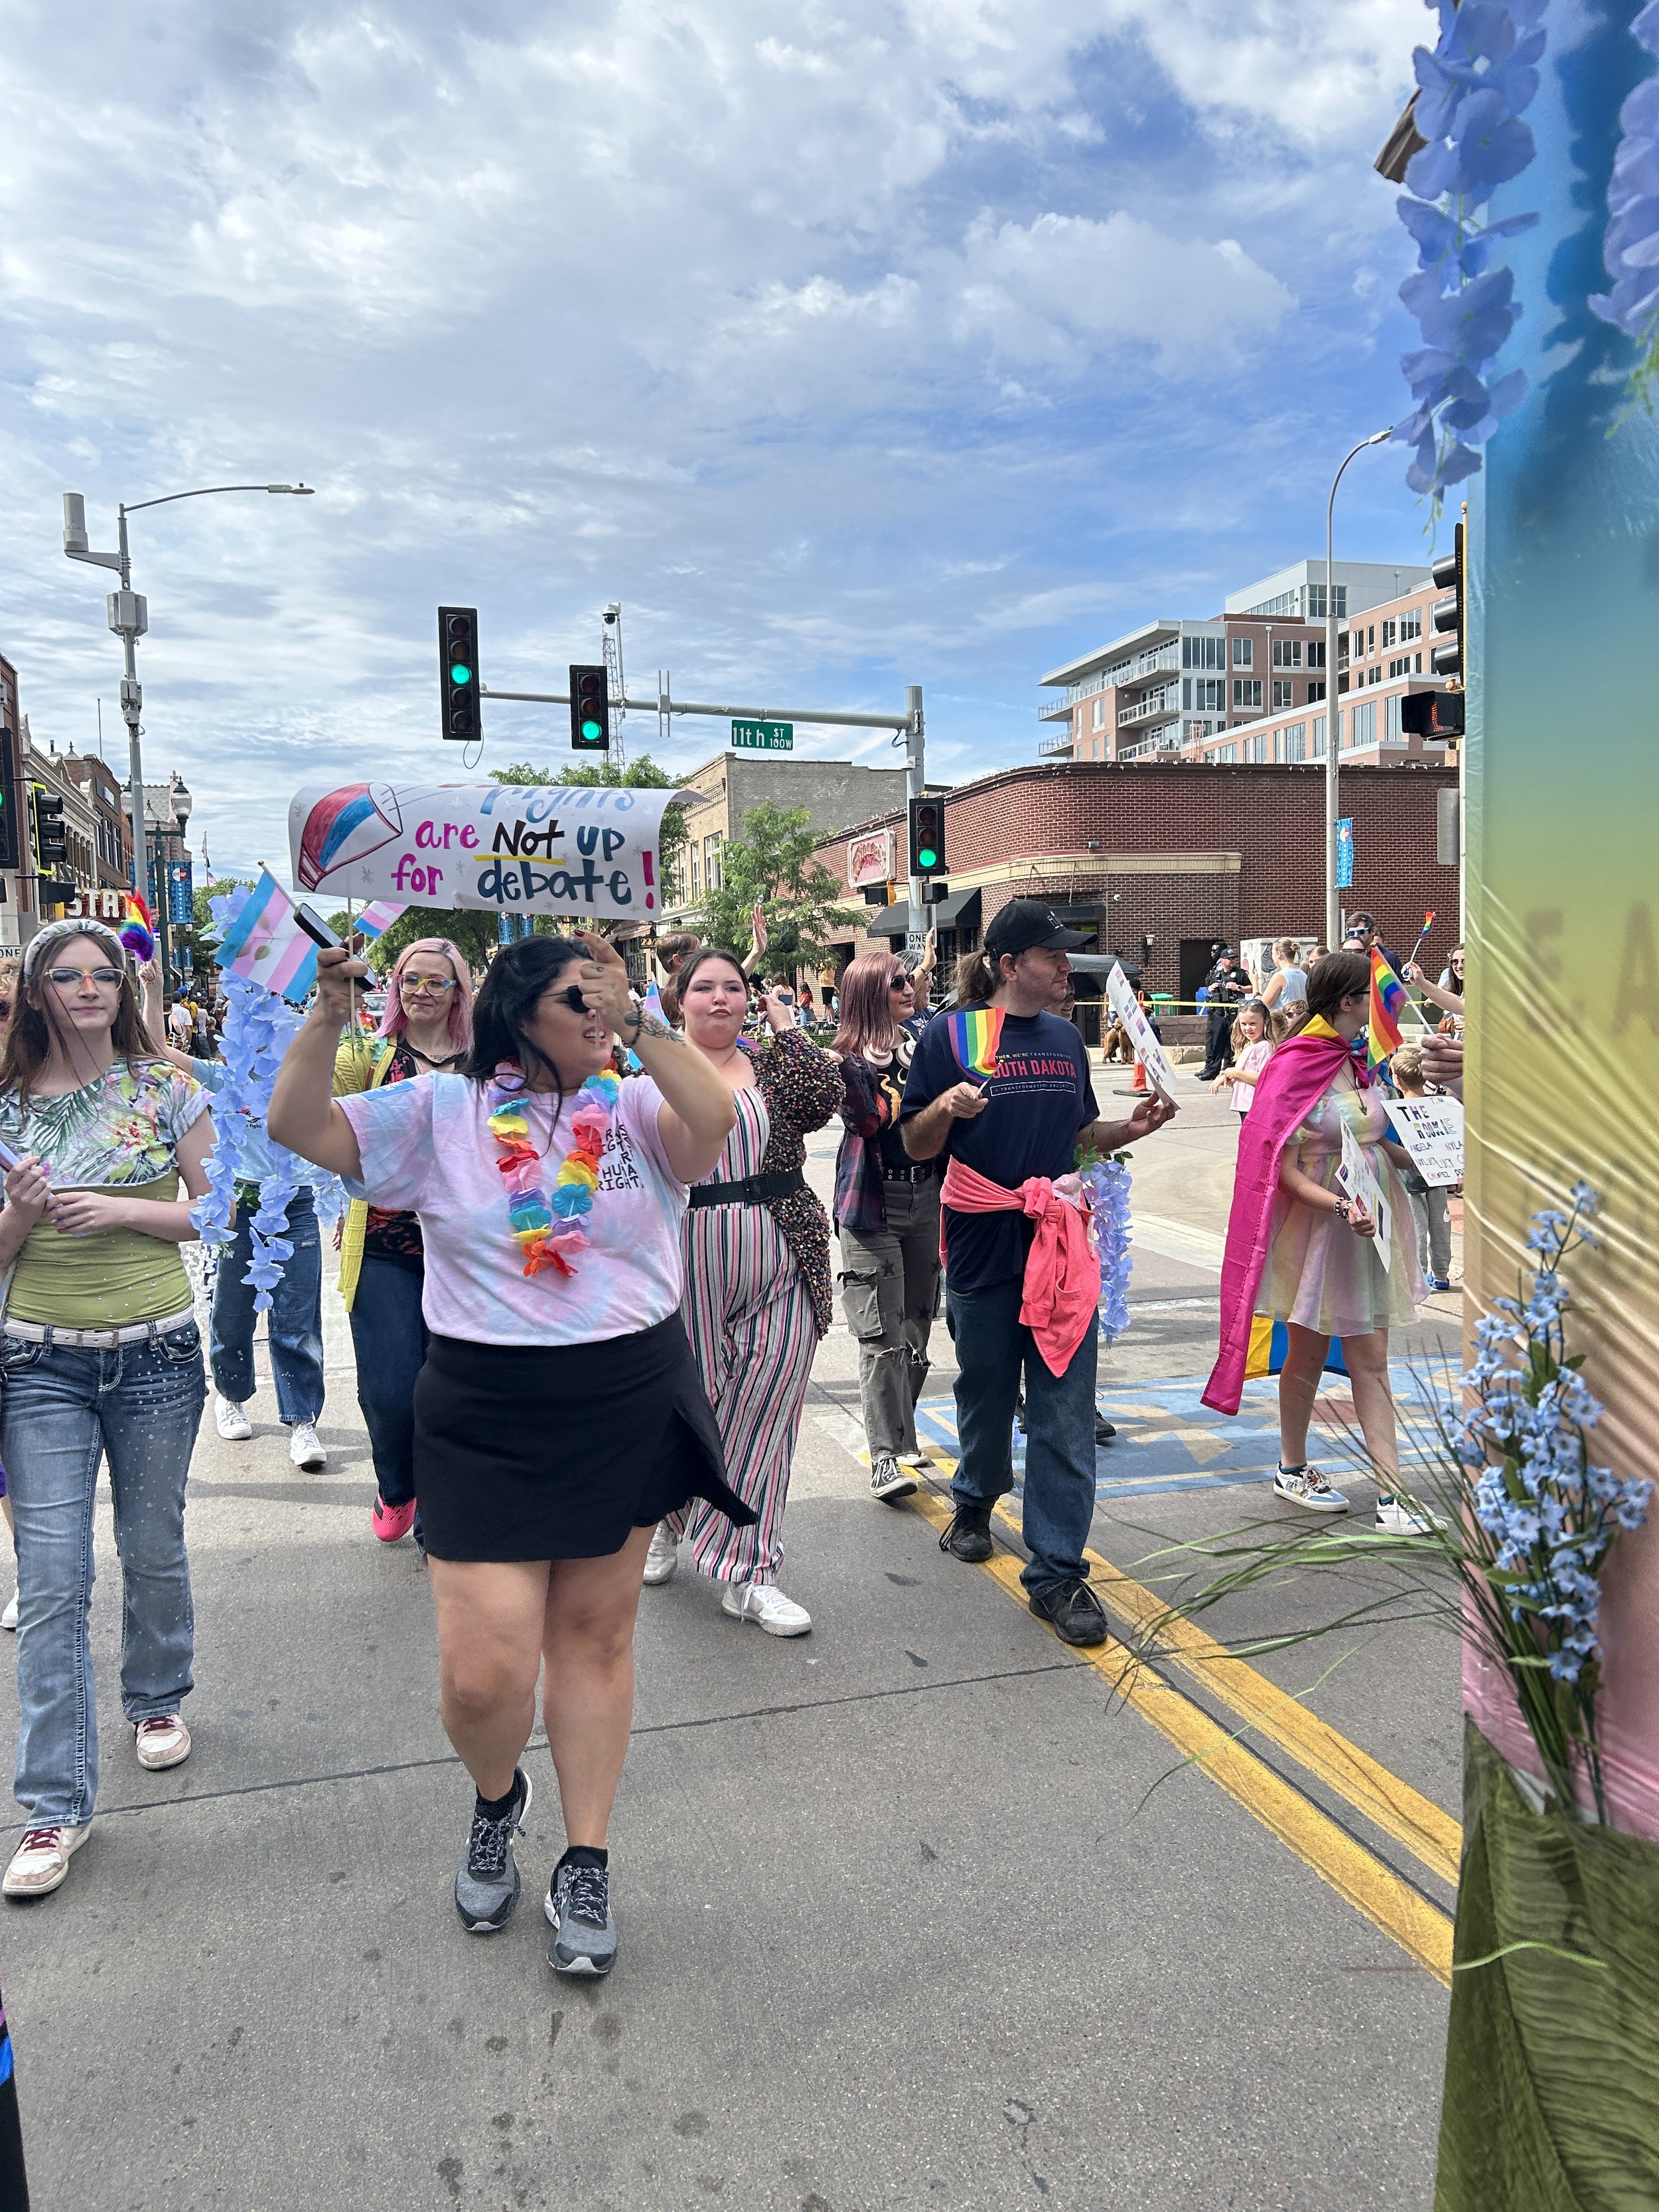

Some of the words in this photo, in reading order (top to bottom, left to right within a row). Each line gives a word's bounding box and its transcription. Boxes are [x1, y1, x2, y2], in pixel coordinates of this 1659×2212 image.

[733, 727, 765, 747] 11th
[773, 727, 784, 738] ST
[770, 738, 792, 749] 100W
[415, 820, 480, 849] are
[390, 853, 444, 895] for
[909, 934, 927, 942] ONE
[992, 1060, 1029, 1079] OUTH
[1029, 1059, 1077, 1078] DAKOTA
[1396, 1105, 1429, 1122] THE
[596, 1175, 644, 1191] RIGHT
